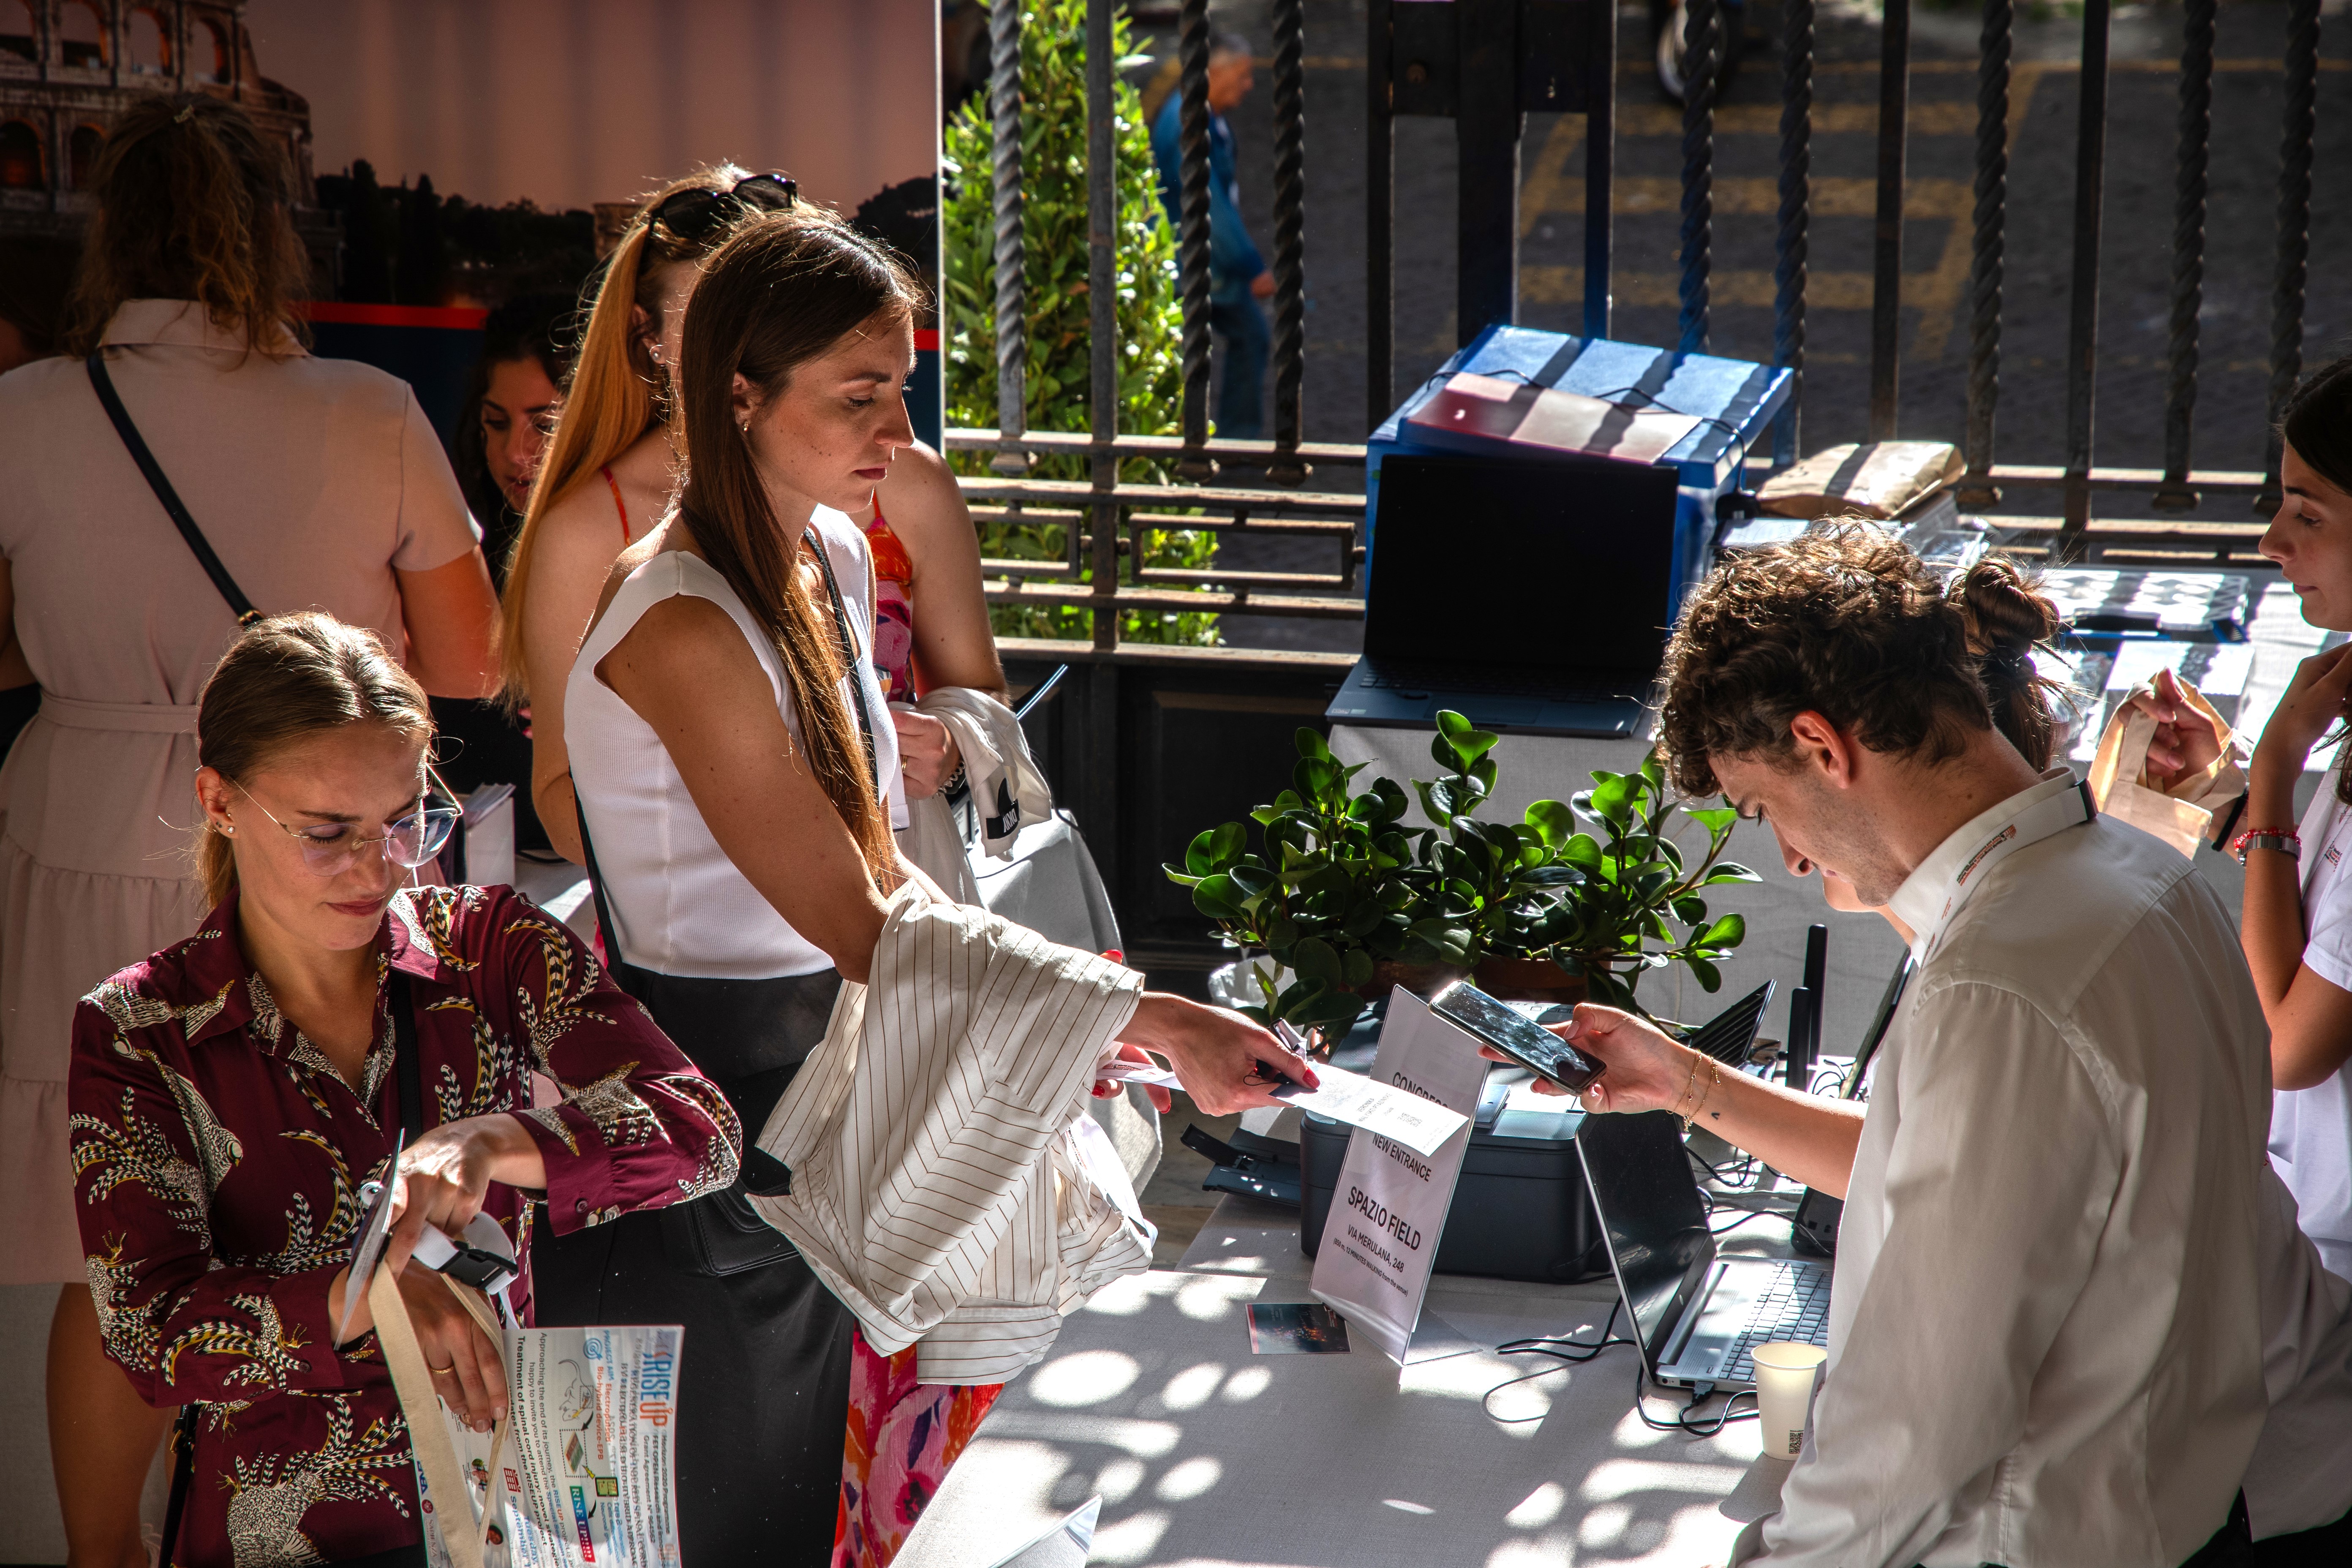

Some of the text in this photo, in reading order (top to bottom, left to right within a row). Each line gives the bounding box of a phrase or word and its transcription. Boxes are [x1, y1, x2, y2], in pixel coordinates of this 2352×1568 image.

[1002, 808, 1018, 833] DKNY
[1392, 1072, 1448, 1108] CONGR
[1372, 1132, 1391, 1153] NEW
[1390, 1144, 1432, 1182] ENTRANCE
[1348, 1186, 1421, 1251] SPAZIO FIELD
[1348, 1224, 1404, 1273] VIA MERULANA, 248
[1333, 1238, 1341, 1247] (850
[1341, 1243, 1345, 1252] m,
[1346, 1246, 1350, 1254] 12
[1350, 1250, 1367, 1265] MINUTES
[1367, 1260, 1383, 1277] WALKING
[1382, 1272, 1391, 1283] from
[1396, 1284, 1408, 1297] venue)
[516, 1336, 525, 1390] Treatment
[538, 1333, 547, 1386] Approaching
[603, 1330, 612, 1364] PROJECT
[528, 1362, 536, 1388] happy
[517, 1392, 525, 1402] of
[529, 1389, 535, 1398] to
[518, 1405, 529, 1436] spinal
[539, 1402, 547, 1418] end
[541, 1420, 547, 1429] of
[595, 1366, 604, 1460] Bio-hybrid device-EPB
[525, 1437, 534, 1460] cord
[537, 1450, 546, 1476] attend
[542, 1441, 553, 1473] journey,
[509, 1386, 517, 1427] dates
[514, 1429, 523, 1452] from
[525, 1473, 538, 1509] RISEUP
[534, 1510, 547, 1546] project
[531, 1462, 542, 1493] injury:
[643, 1459, 652, 1502] Agreement
[538, 1495, 549, 1522] novel
[546, 1491, 557, 1522] Special
[553, 1490, 564, 1522] RISEUP
[600, 1502, 608, 1531] Neuronal
[428, 1519, 438, 1558] SAPIENZA
[510, 1496, 527, 1557] September
[559, 1522, 572, 1552] project
[572, 1488, 592, 1558] RISE UP!!!!!
[524, 1516, 538, 1565] Tuesday,
